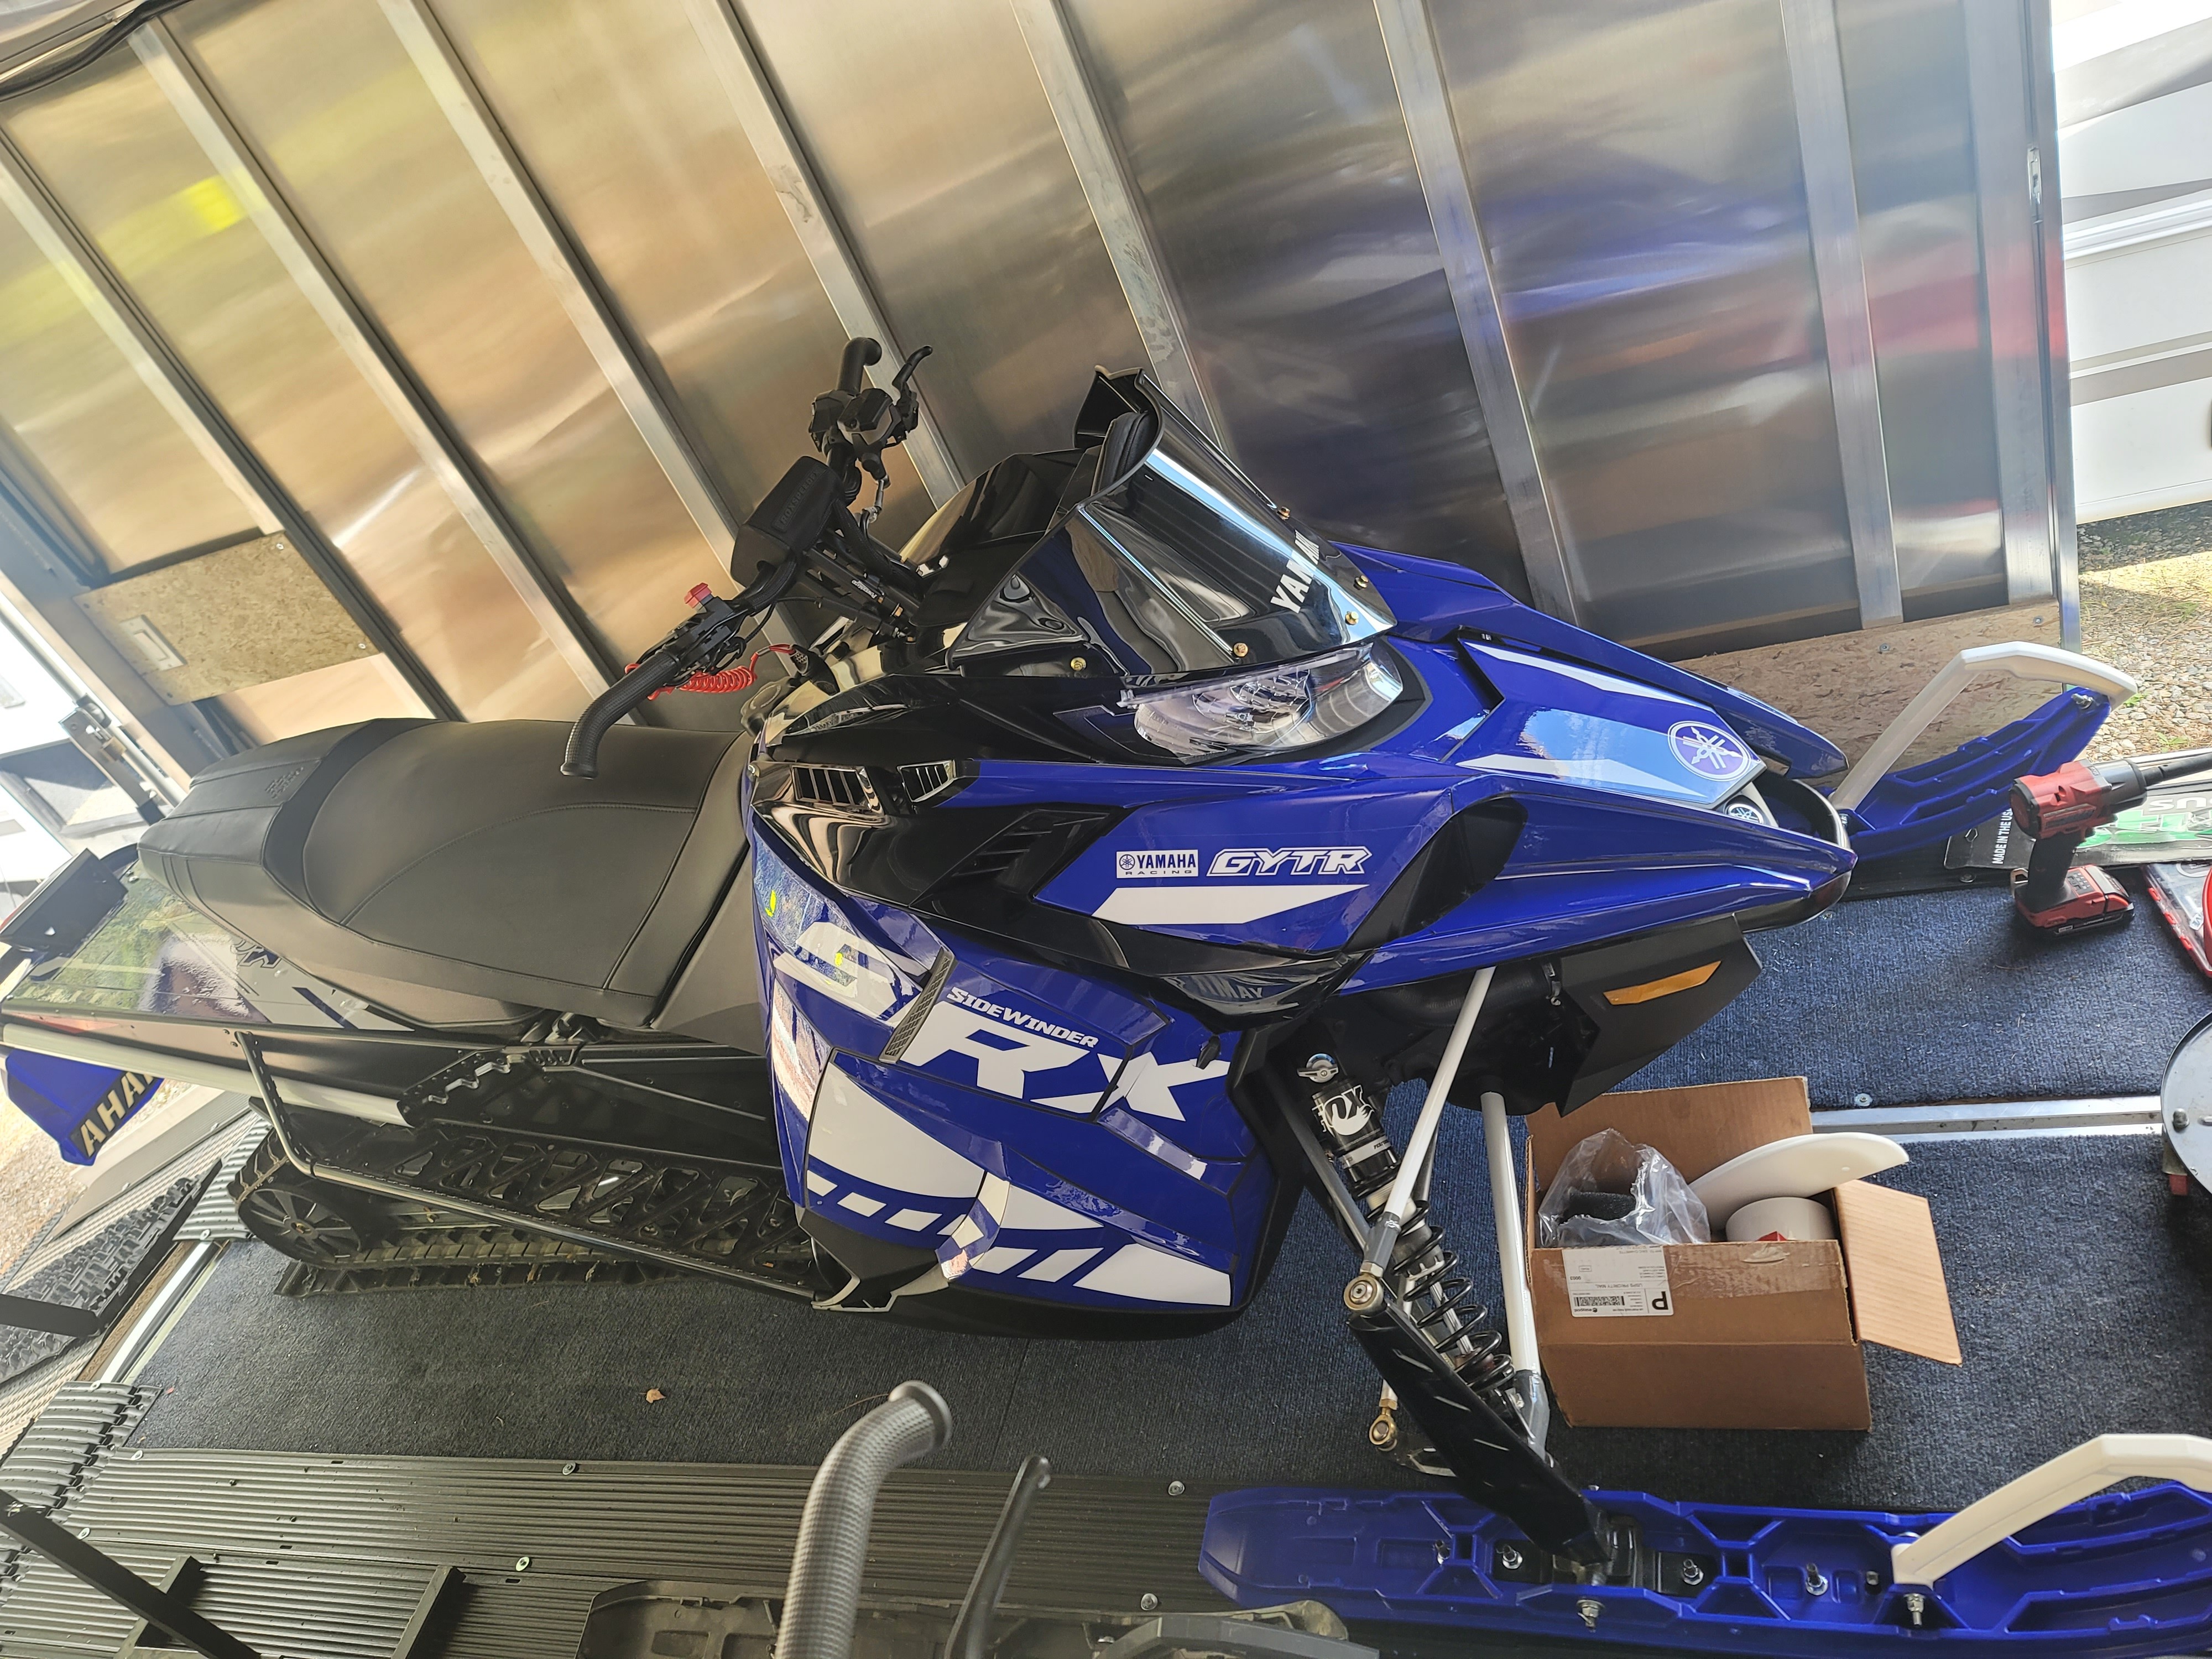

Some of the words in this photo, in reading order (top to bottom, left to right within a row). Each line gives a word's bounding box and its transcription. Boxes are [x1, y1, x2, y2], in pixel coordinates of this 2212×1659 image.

[1998, 822, 2011, 835] THE
[1137, 853, 1196, 869] YAMAHA
[1206, 846, 1372, 876] GYTR
[1992, 844, 2007, 864] MADE
[946, 987, 1099, 1048] SIDEWINDER
[1652, 1291, 1668, 1310] P
